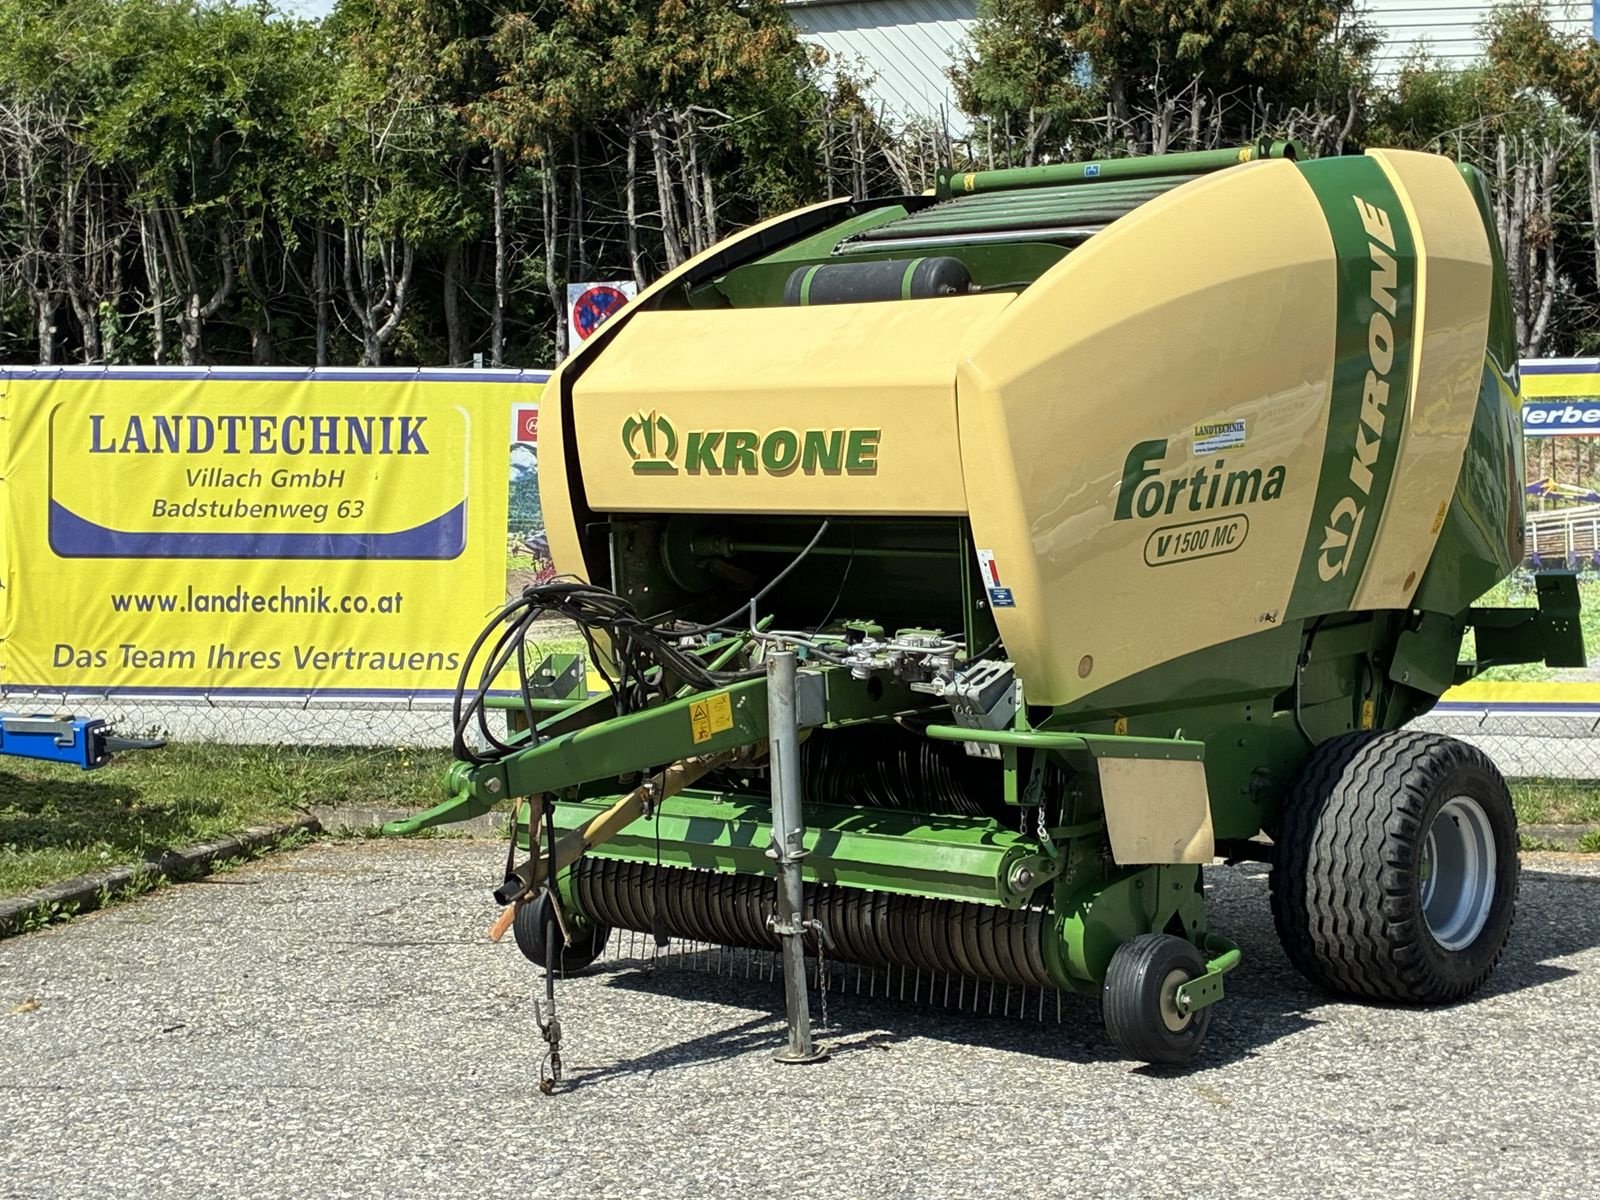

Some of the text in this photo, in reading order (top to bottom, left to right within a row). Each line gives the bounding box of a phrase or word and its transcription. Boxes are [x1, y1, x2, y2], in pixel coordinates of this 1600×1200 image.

[1350, 195, 1397, 495] KRONE
[89, 415, 429, 455] LANDTECHNIK
[1194, 421, 1245, 436] LANDTECHNIK
[685, 428, 881, 477] KRONE
[186, 468, 345, 488] Villach GmbH
[1113, 438, 1286, 521] Fortima
[152, 498, 364, 523] Badstubenweg 63
[1157, 523, 1238, 557] V 1500 MC
[111, 585, 403, 614] www.landtechnik.co.at
[53, 643, 460, 672] Das Team Ihres Vertrauens
